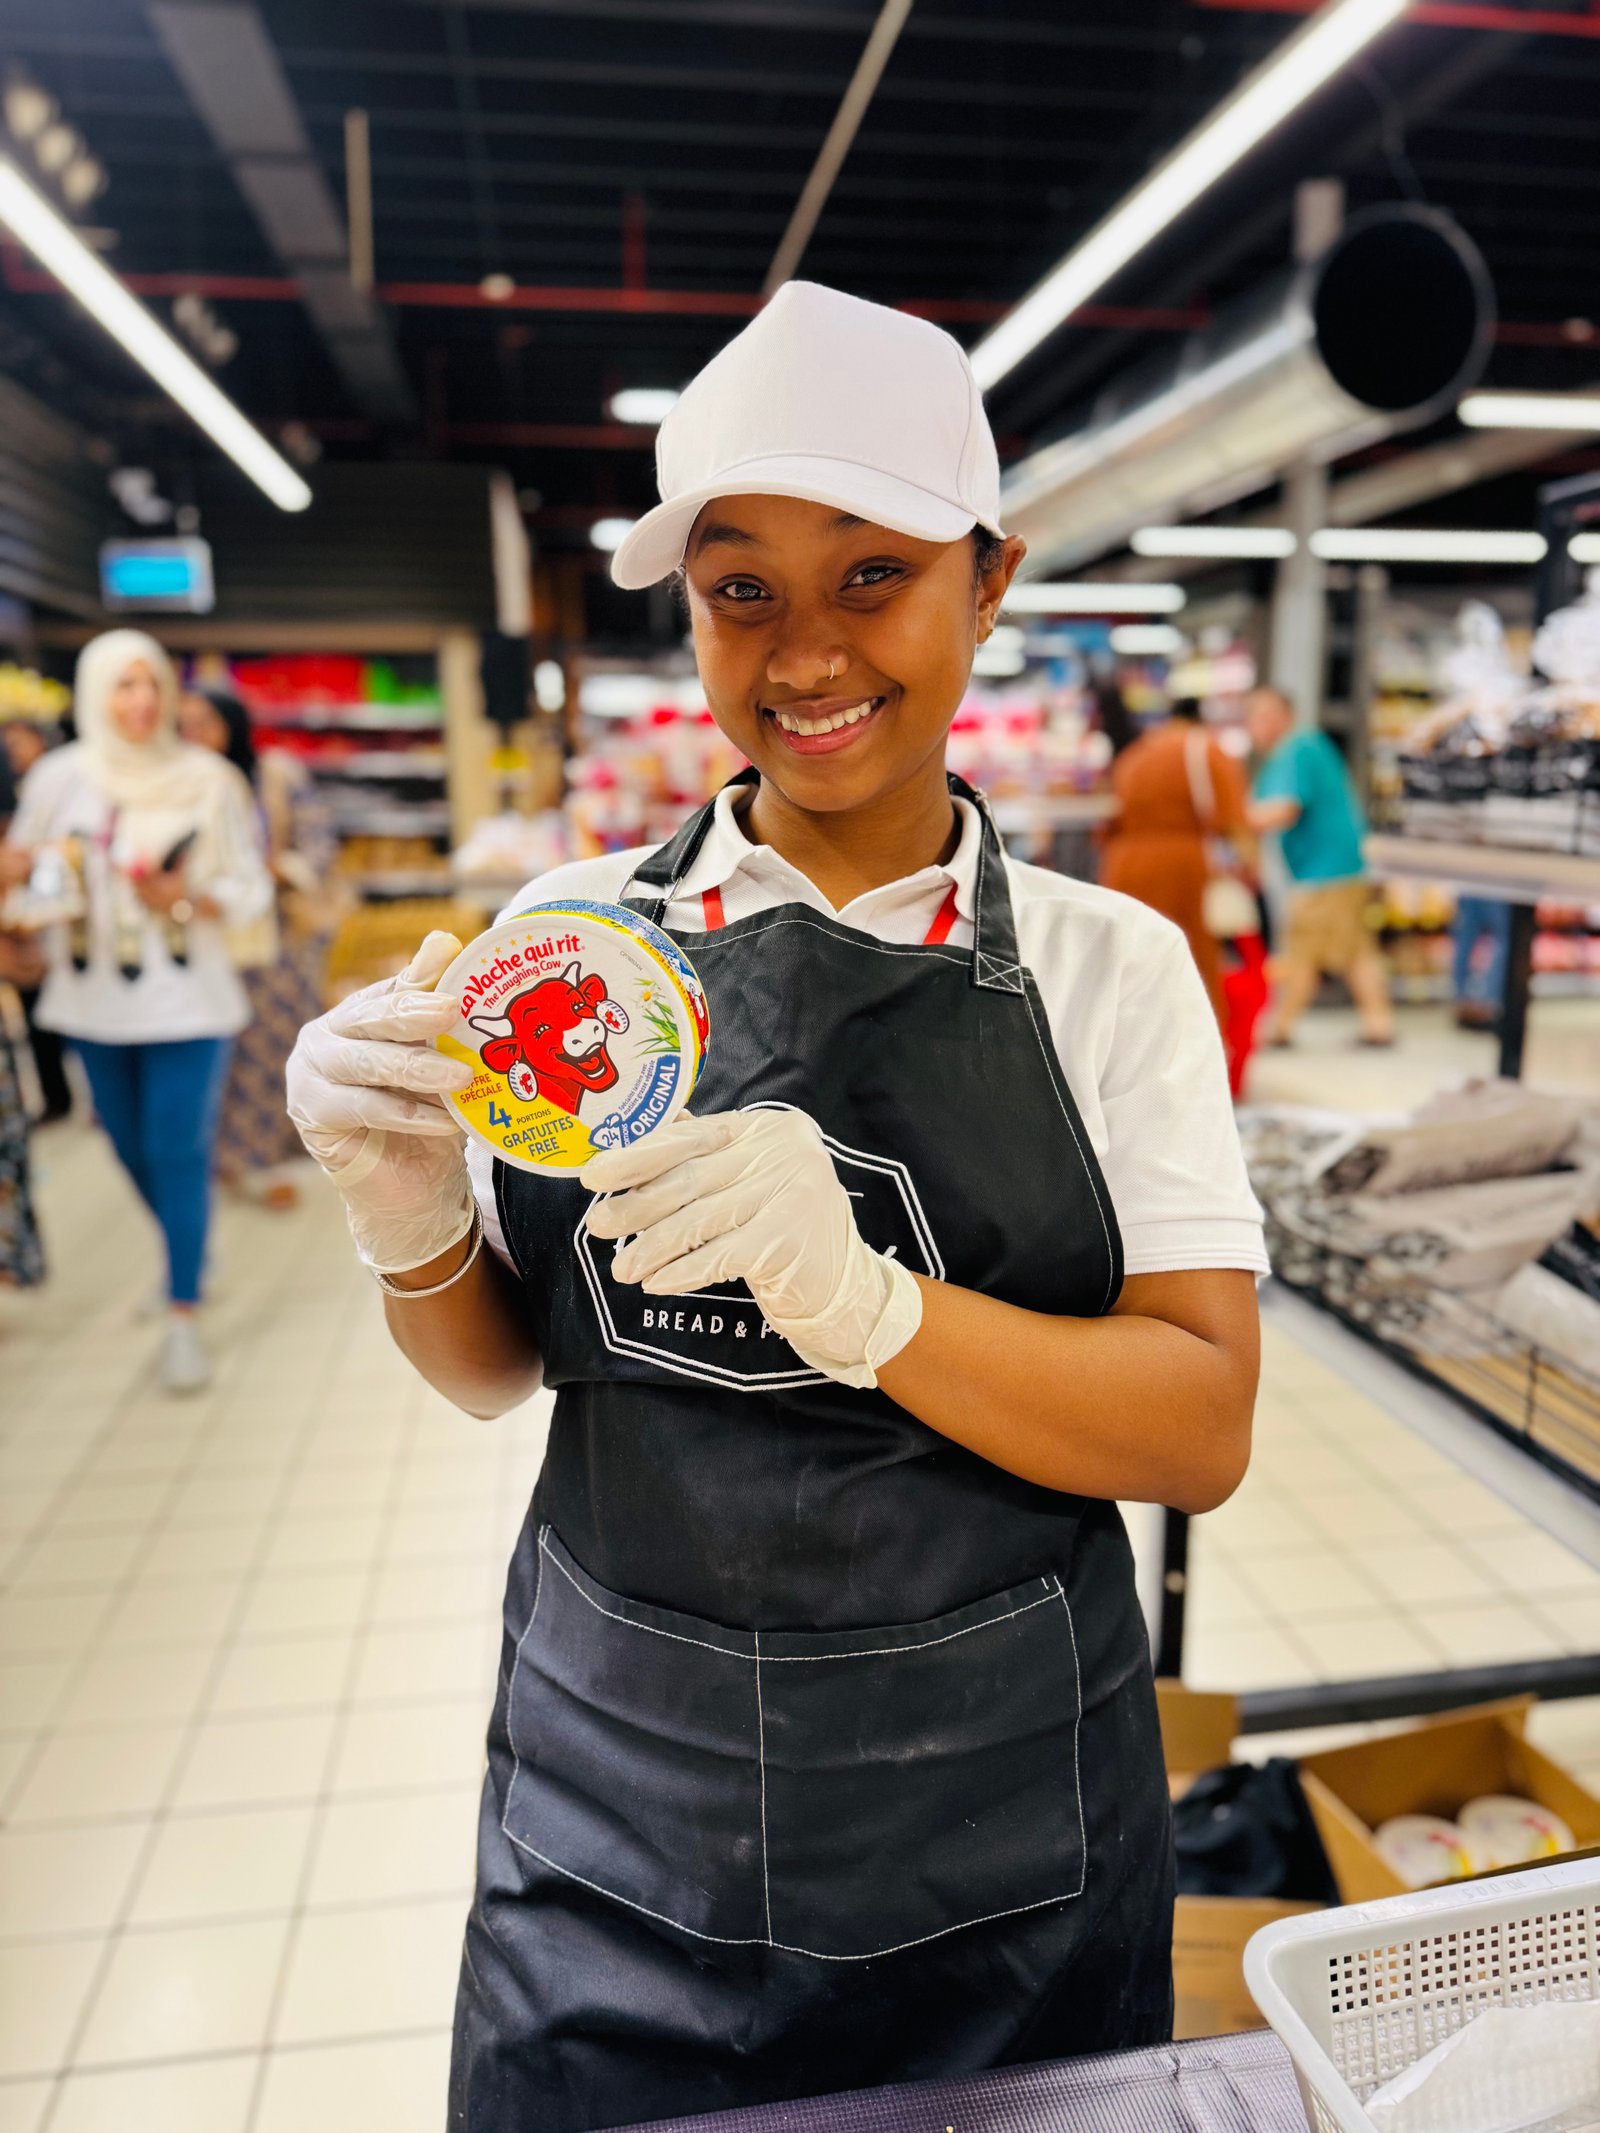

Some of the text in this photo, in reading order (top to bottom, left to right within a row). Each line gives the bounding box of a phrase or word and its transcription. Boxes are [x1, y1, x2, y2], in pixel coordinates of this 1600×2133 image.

[464, 953, 524, 996] Vache
[524, 937, 554, 962] qui
[556, 933, 581, 954] rit
[483, 960, 561, 1009] The Laughing Cow
[460, 1082, 503, 1104] SPÉCIALE
[630, 1062, 676, 1137] ORIGINAL
[488, 1101, 552, 1128] 4 PORTIONS
[502, 1115, 574, 1148] GRATUITES
[601, 1130, 620, 1147] 24
[527, 1136, 560, 1157] FREE
[643, 1309, 724, 1334] BREAD
[734, 1320, 748, 1338] &
